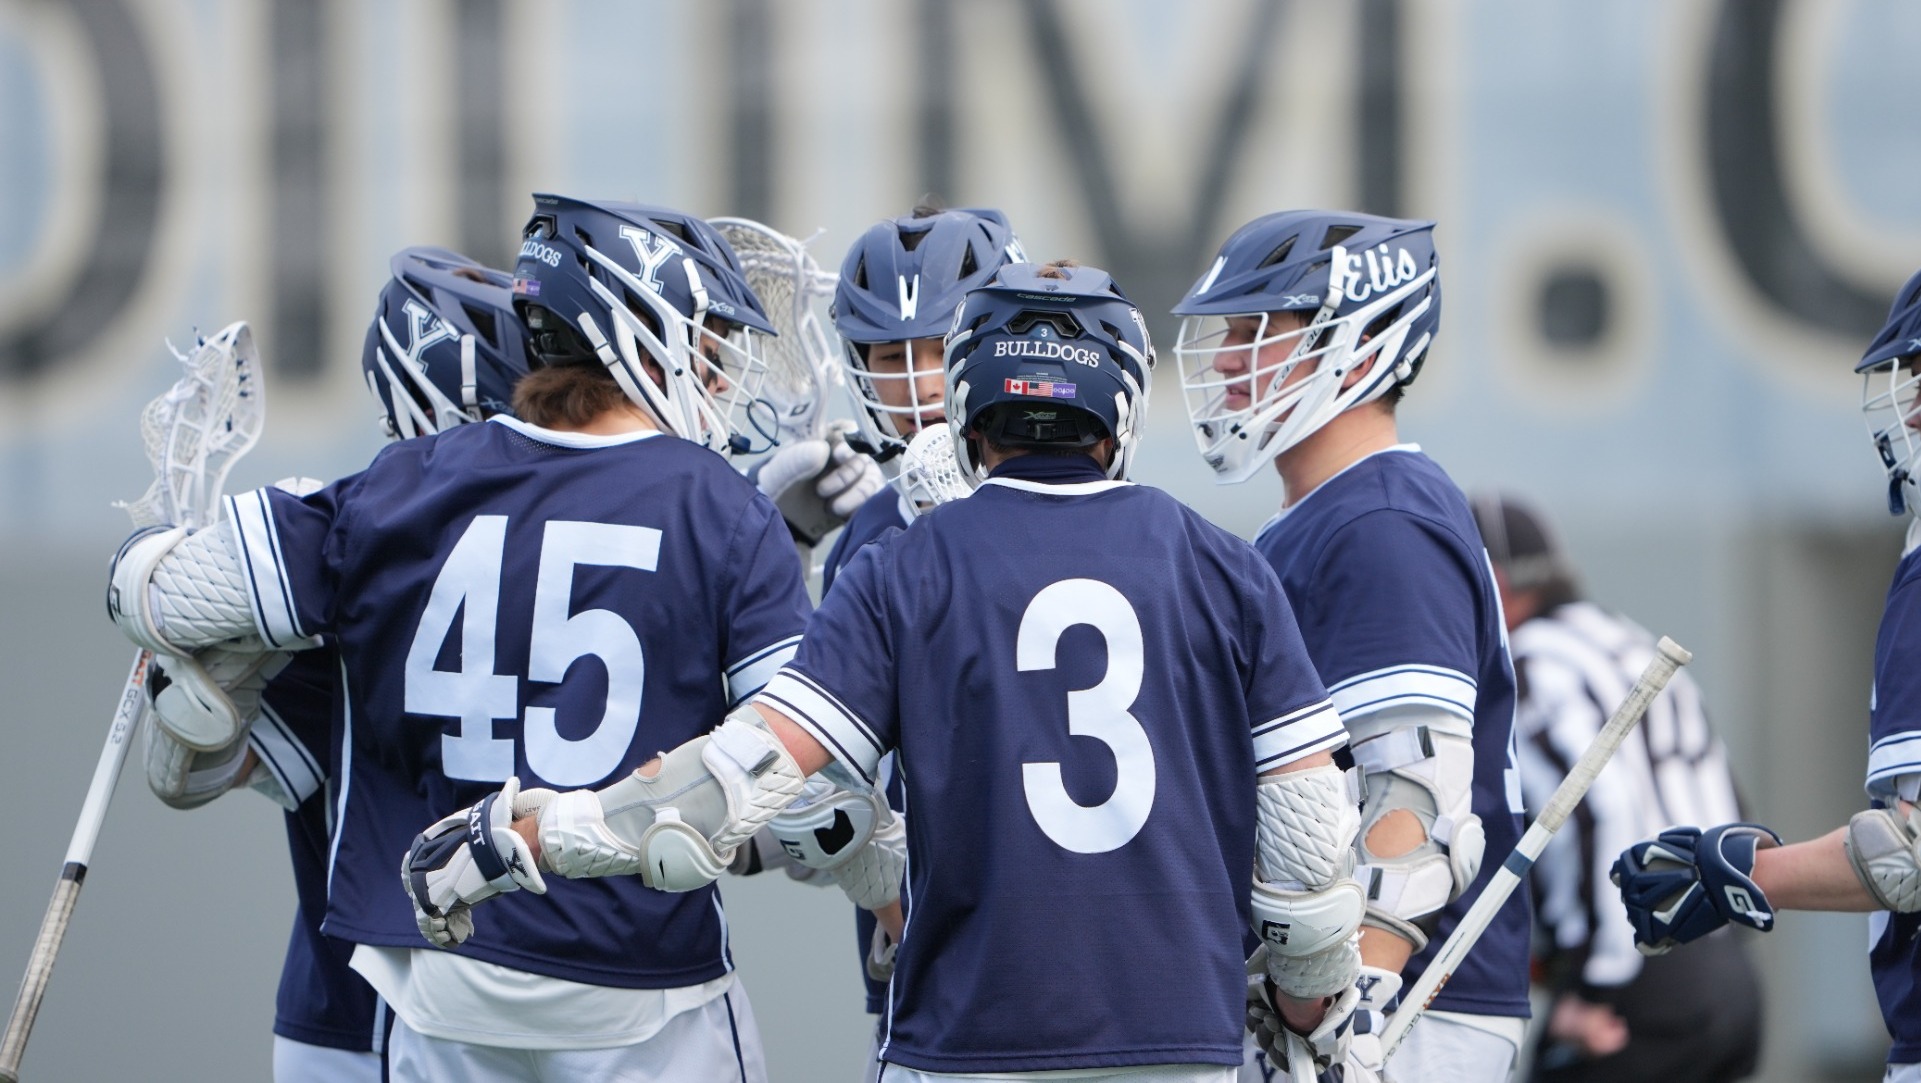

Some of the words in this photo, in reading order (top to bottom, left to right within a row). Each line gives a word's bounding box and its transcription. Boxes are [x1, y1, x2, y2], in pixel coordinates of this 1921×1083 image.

[518, 241, 562, 267] LLDOGS
[619, 224, 683, 295] Y
[1342, 243, 1417, 302] Elis
[401, 298, 460, 375] Y
[994, 341, 1100, 368] BULLDOGS
[1040, 328, 1048, 337] 3
[403, 514, 663, 788] 45
[1016, 578, 1156, 854] 3
[470, 801, 485, 846] GAIT
